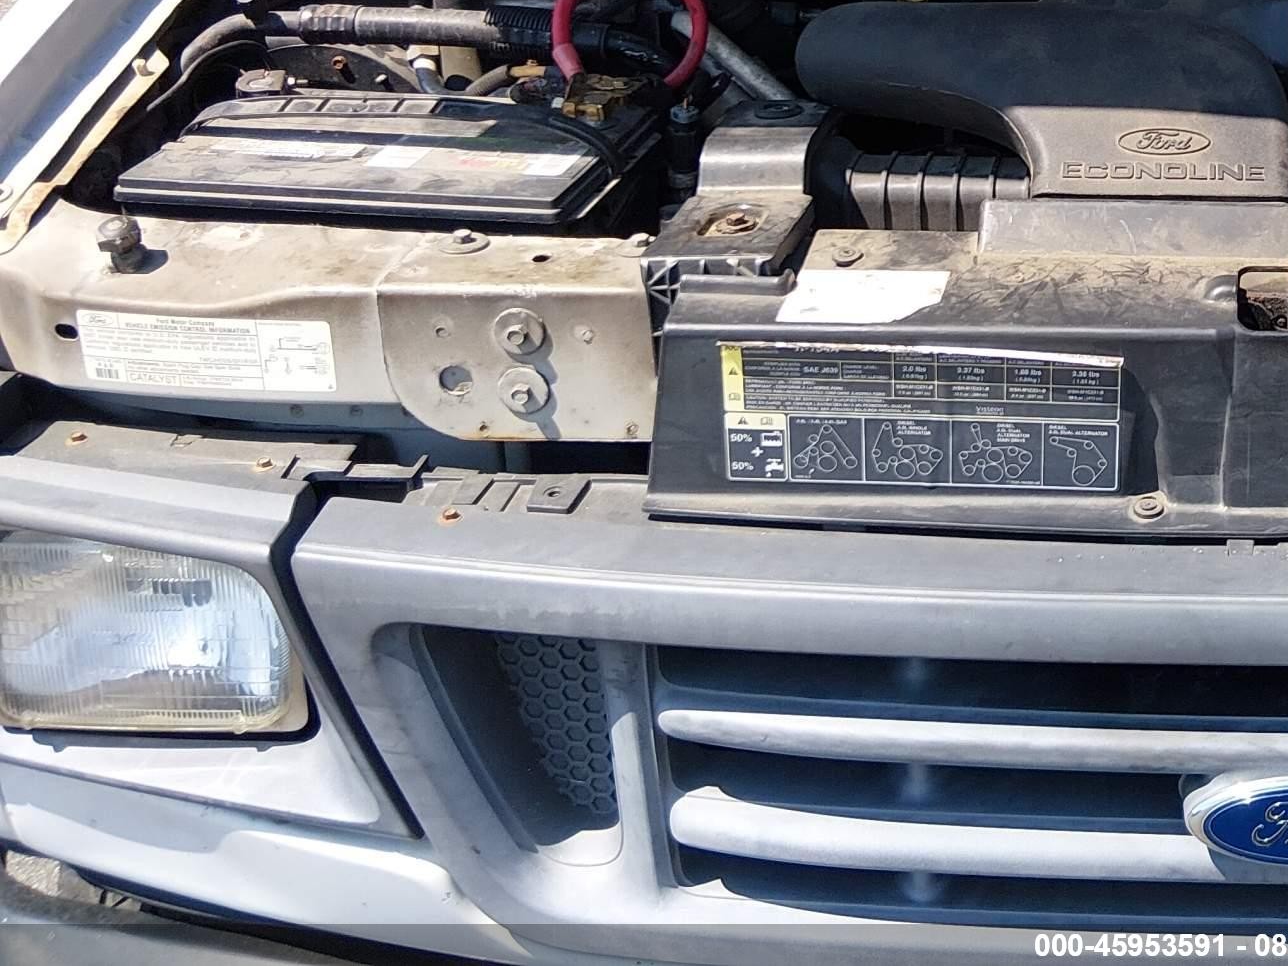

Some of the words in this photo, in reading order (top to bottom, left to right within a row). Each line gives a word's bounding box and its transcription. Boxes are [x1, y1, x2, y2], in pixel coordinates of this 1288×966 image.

[1135, 130, 1193, 151] Ford
[1061, 160, 1266, 182] ECONOLINE
[803, 366, 820, 374] SAE
[129, 372, 177, 384] CATALYST
[730, 433, 753, 443] 50%
[731, 461, 754, 471] 50%
